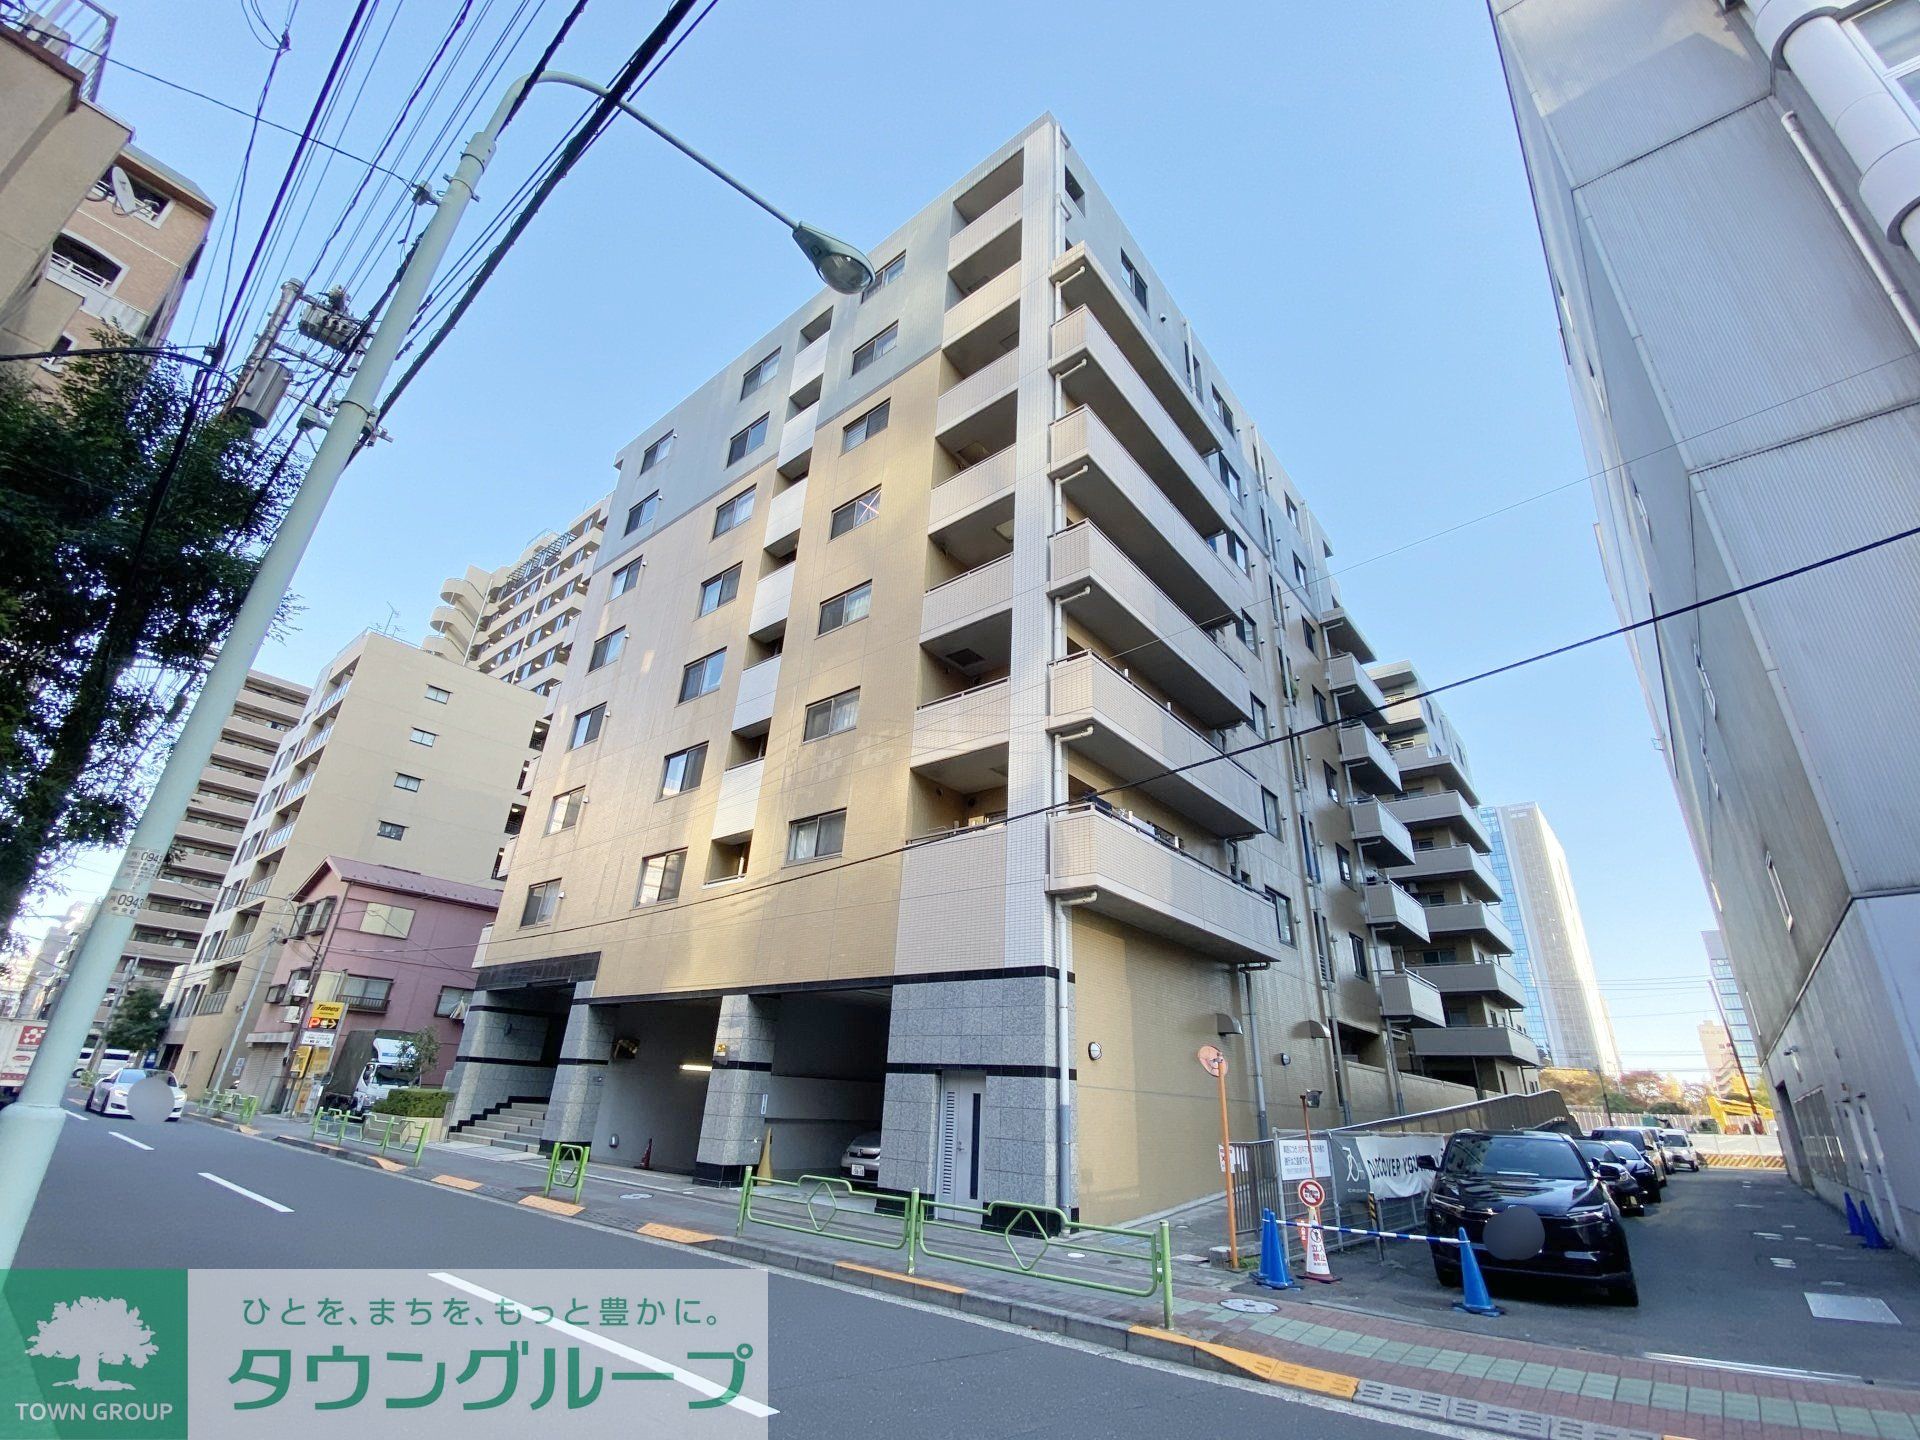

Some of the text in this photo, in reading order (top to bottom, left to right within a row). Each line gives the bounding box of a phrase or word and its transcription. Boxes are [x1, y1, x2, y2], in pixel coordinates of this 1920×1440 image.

[118, 895, 144, 909] 0943
[317, 1004, 340, 1012] Times
[309, 1017, 320, 1028] P
[1367, 1156, 1401, 1179] DISCOVER
[1312, 1253, 1327, 1262] 禁止
